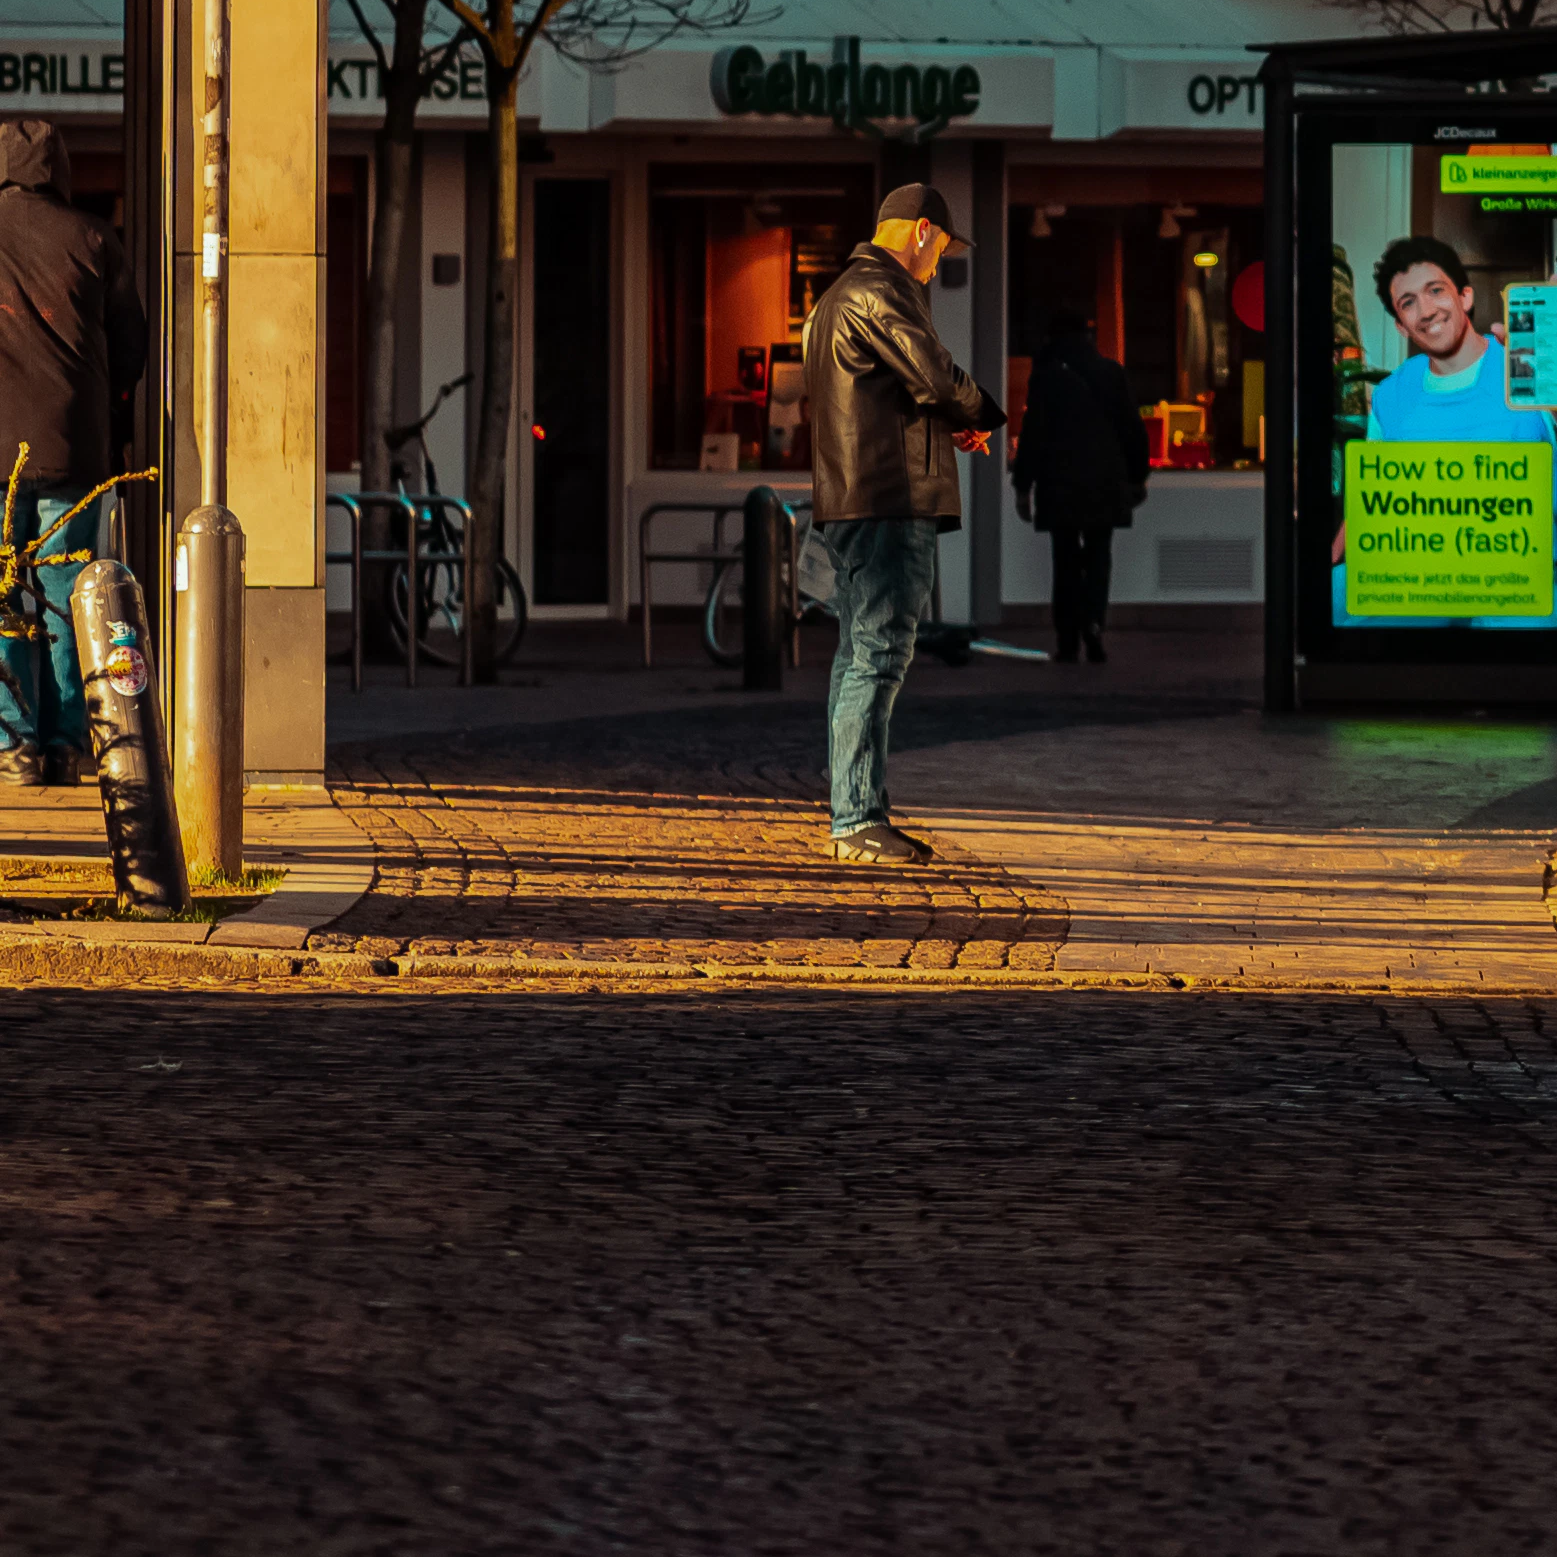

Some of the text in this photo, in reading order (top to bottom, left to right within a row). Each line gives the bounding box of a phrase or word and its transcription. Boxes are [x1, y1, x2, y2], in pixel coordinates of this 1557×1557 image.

[0, 53, 123, 95] BRILLE
[1433, 126, 1497, 140] JCDecaux
[1480, 196, 1523, 212] Große
[1359, 453, 1528, 481] How to find
[1360, 489, 1534, 523] Wohnungen
[1357, 525, 1538, 557] online (fast).
[1357, 570, 1420, 585] Entdecke
